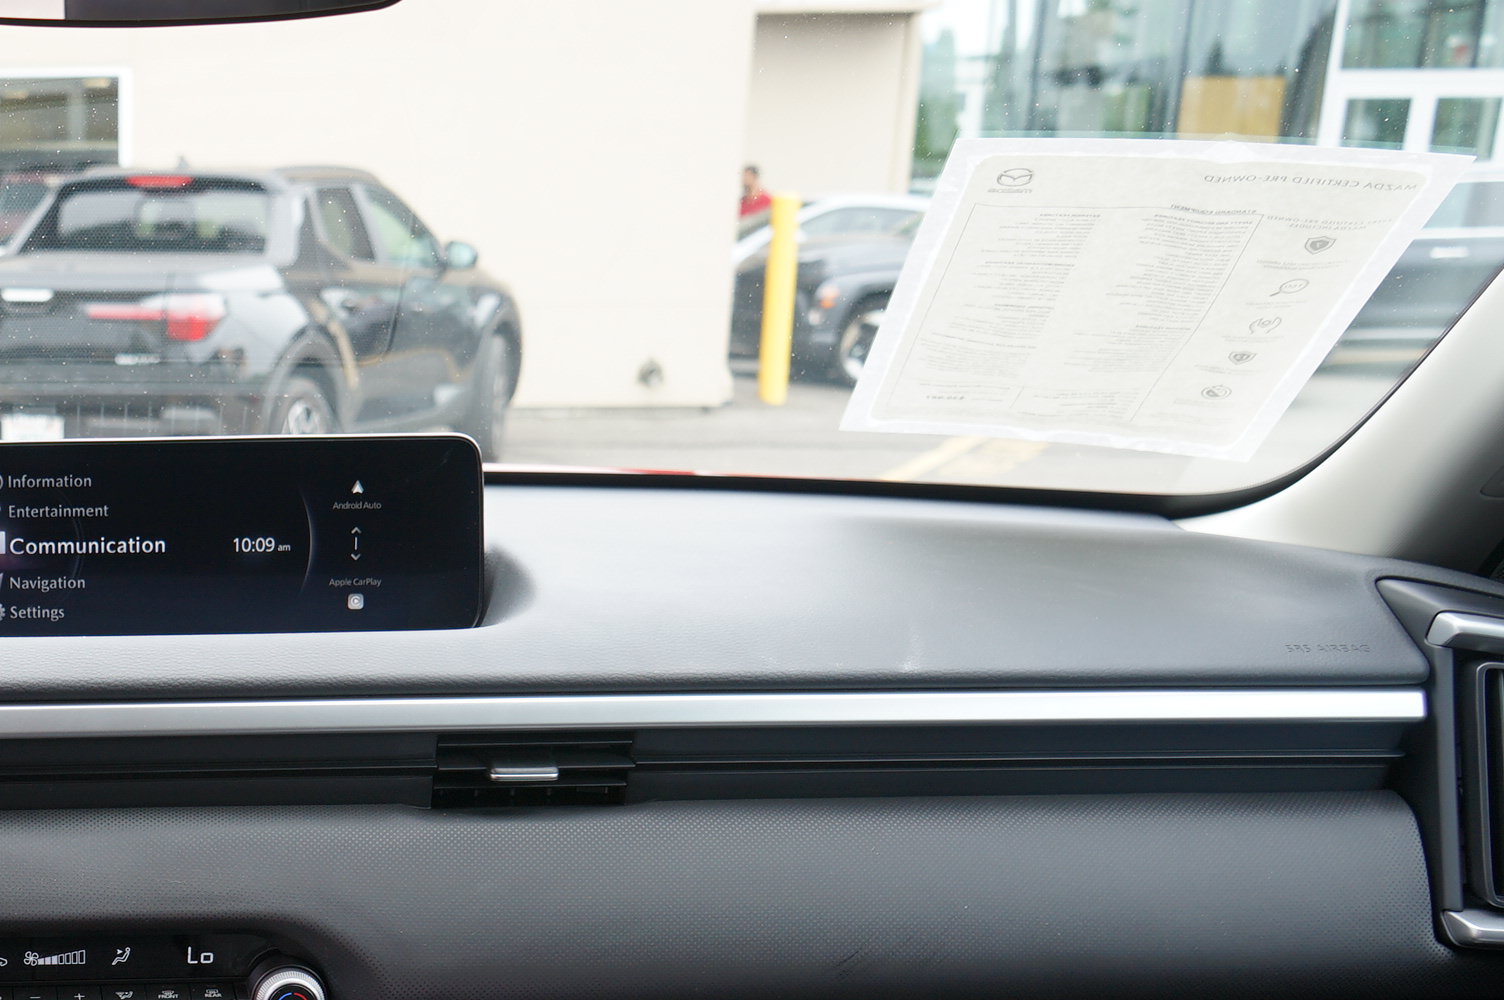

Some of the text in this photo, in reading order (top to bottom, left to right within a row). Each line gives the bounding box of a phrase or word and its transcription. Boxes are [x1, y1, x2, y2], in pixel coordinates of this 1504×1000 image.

[8, 474, 92, 488] Information
[8, 504, 109, 518] Entertainment
[332, 501, 382, 509] Android Auto
[9, 536, 166, 555] Communication
[233, 537, 291, 553] 10:09 am
[9, 576, 86, 593] Navigation
[328, 577, 382, 588] Apple CarPlay
[9, 605, 65, 622] Settings
[187, 946, 214, 965] Lo
